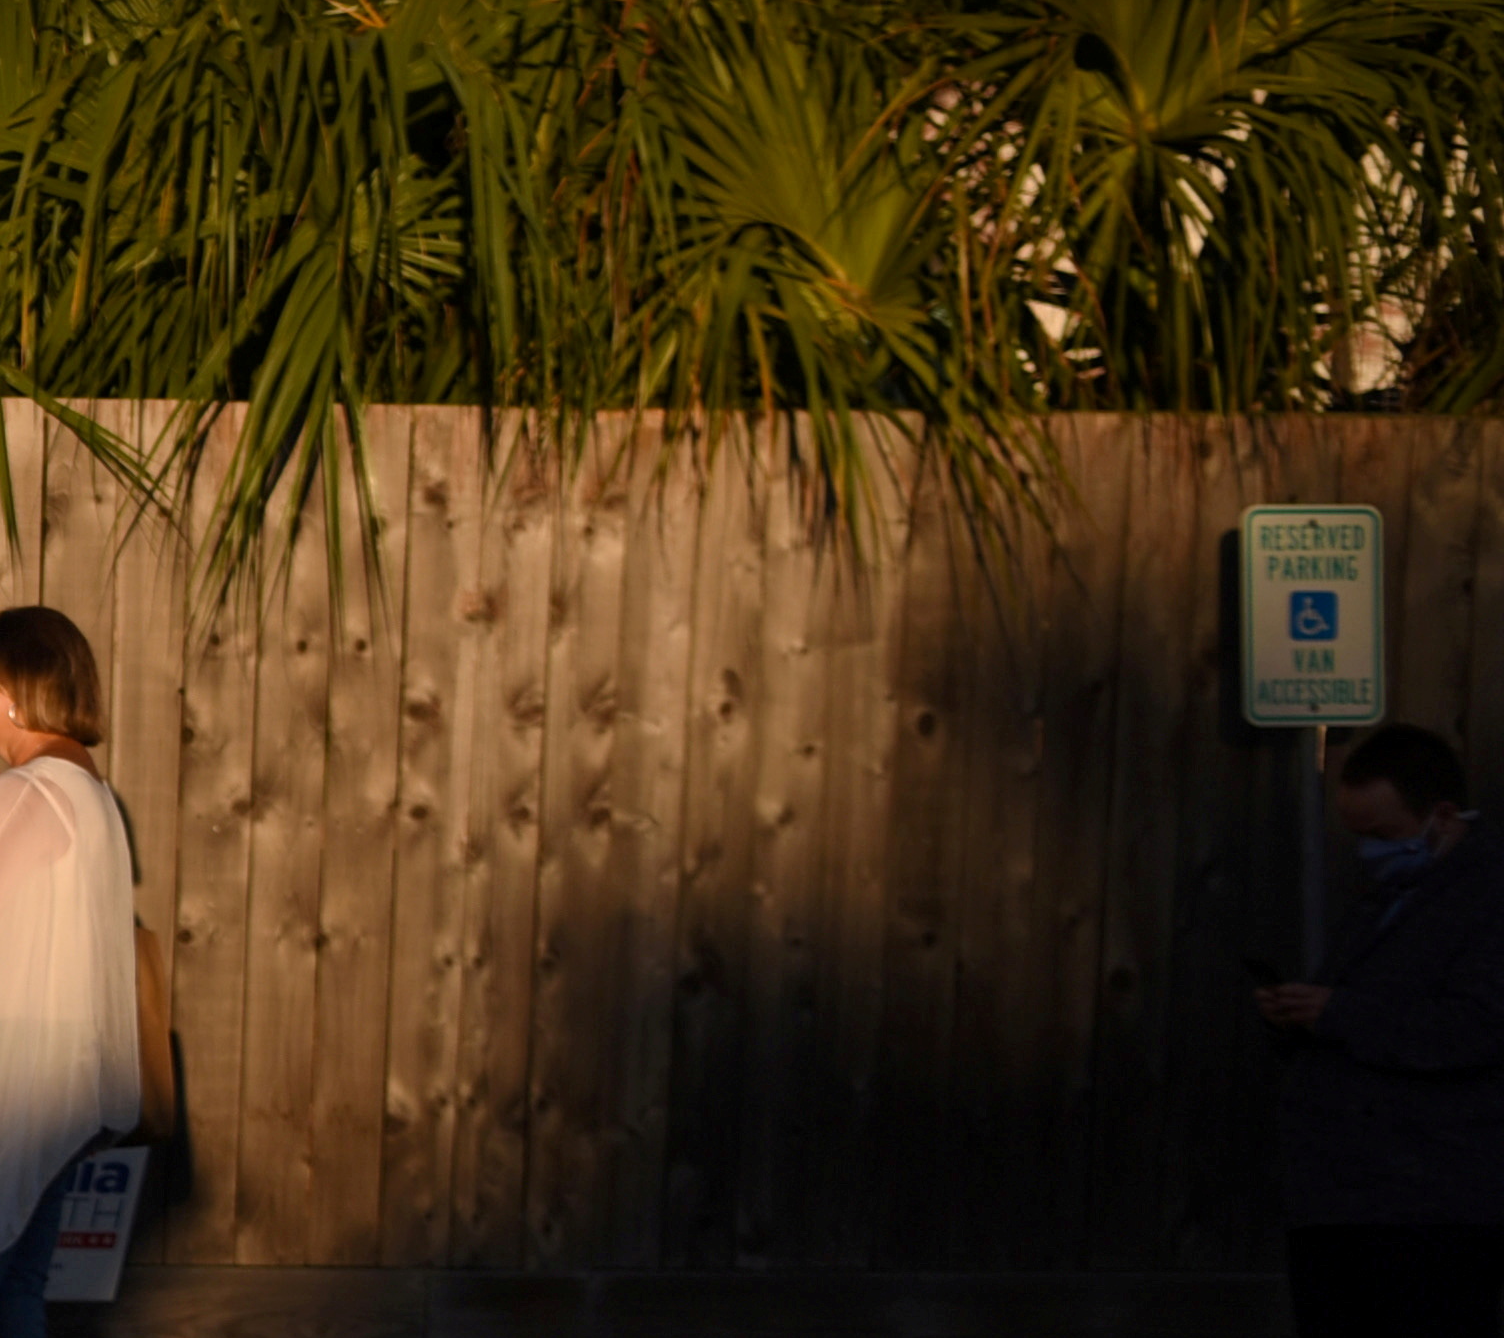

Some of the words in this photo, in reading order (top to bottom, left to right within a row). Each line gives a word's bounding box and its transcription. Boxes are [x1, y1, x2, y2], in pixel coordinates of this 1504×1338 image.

[1260, 524, 1365, 551] RESERVED
[1267, 555, 1358, 581] PARKING
[1293, 649, 1335, 673] VAN
[1257, 677, 1372, 705] ACCESSIBLE
